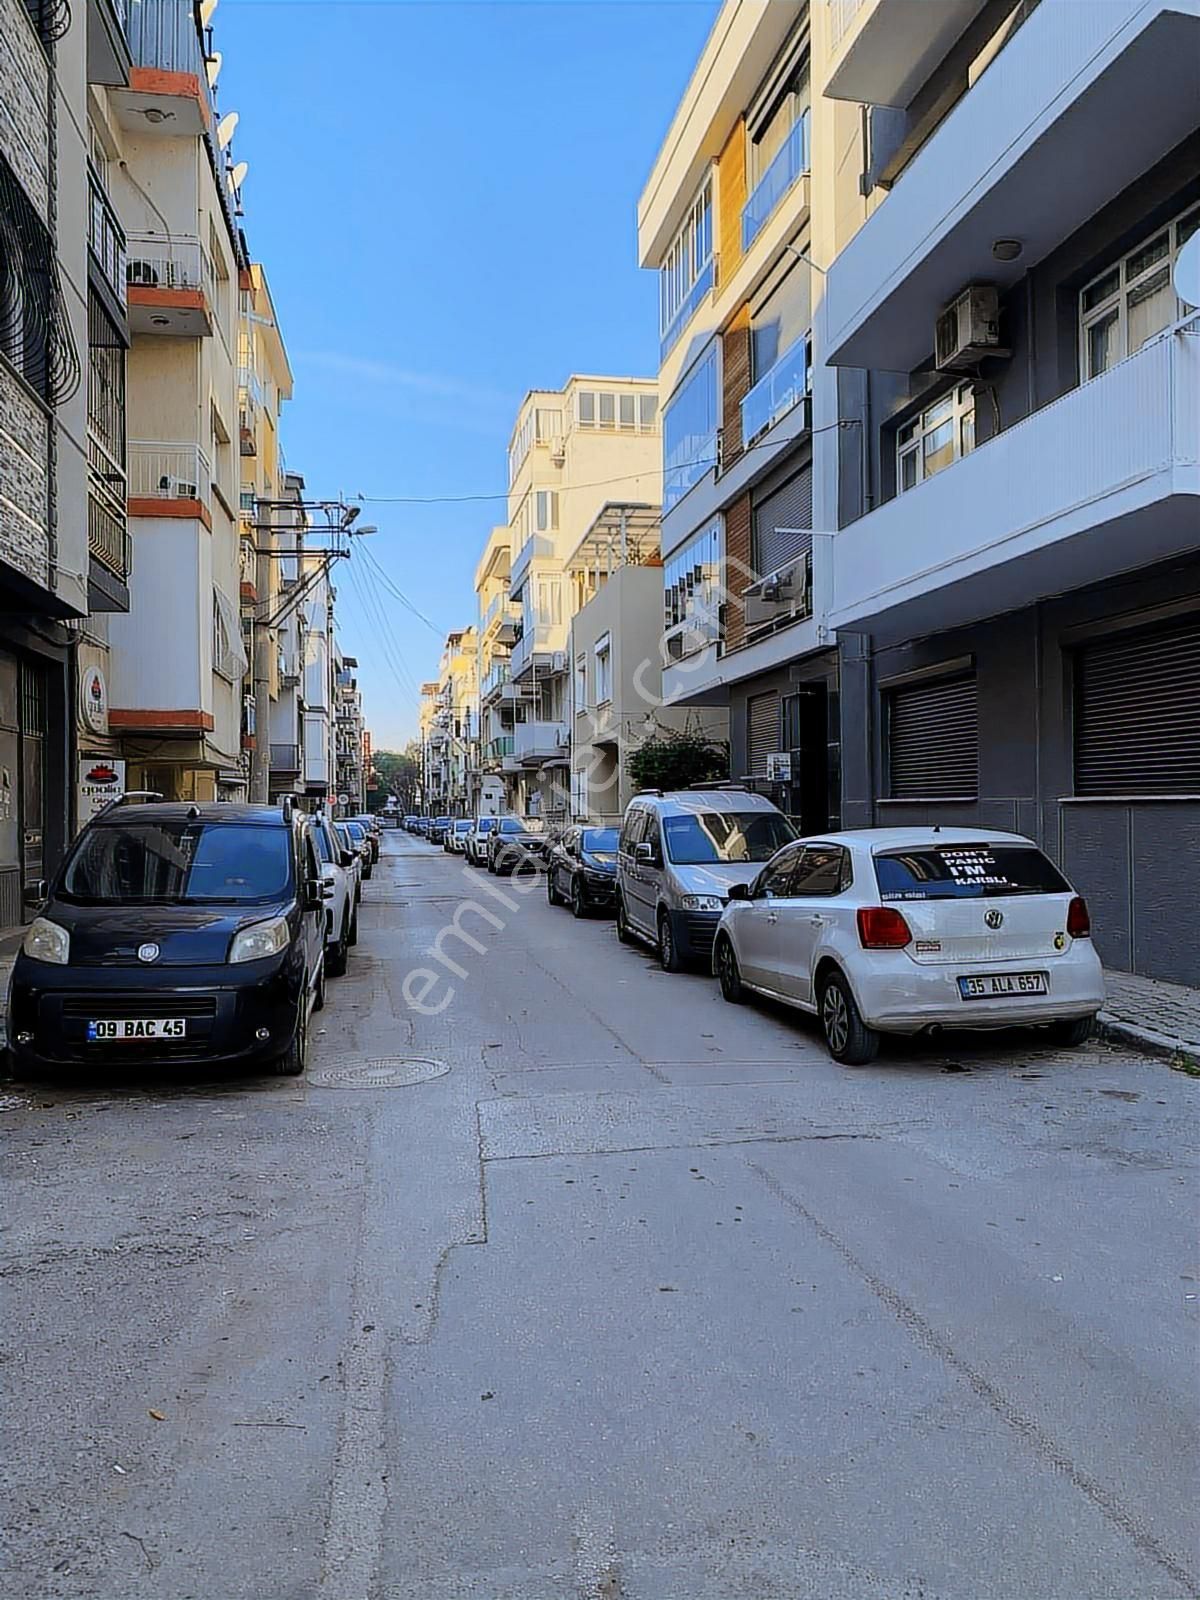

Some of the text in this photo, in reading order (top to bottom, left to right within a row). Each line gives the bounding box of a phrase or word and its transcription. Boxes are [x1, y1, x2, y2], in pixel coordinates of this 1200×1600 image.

[944, 857, 996, 866] PANIC
[949, 865, 986, 876] I'M
[968, 975, 1040, 994] 35 ALA 657
[96, 1021, 117, 1037] 09
[124, 1020, 156, 1037] BAC
[162, 1020, 184, 1036] 45
